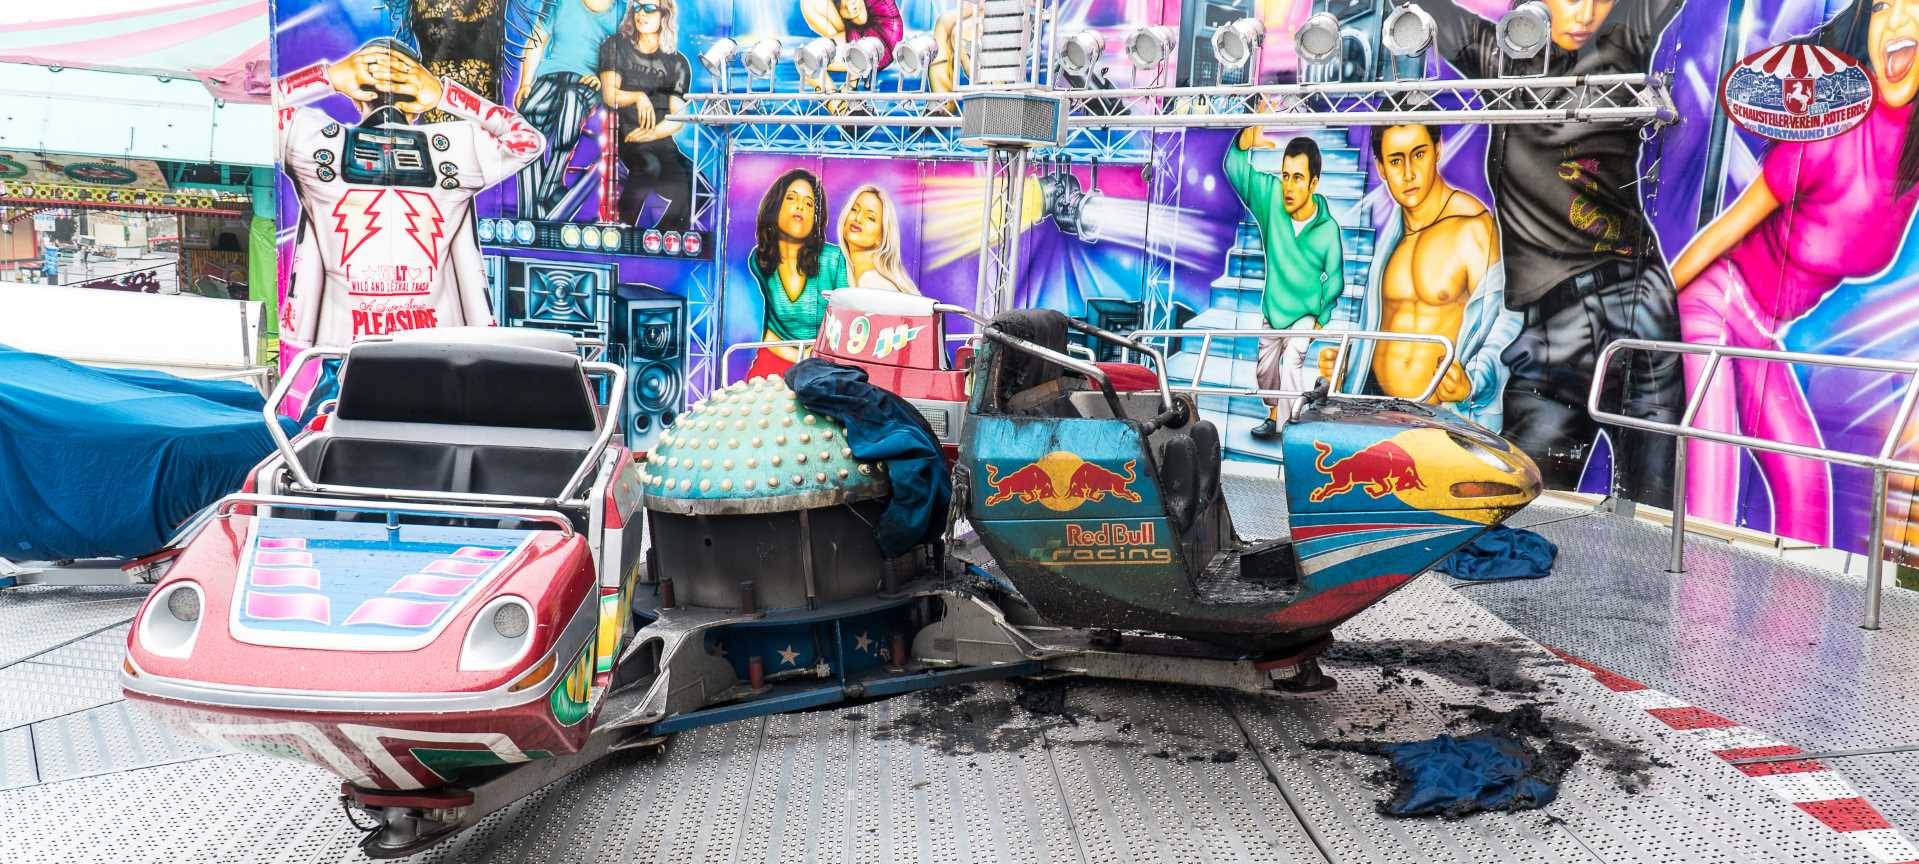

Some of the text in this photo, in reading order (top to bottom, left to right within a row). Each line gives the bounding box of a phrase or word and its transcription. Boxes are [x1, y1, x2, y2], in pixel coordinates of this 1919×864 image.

[1758, 124, 1825, 140] DORTMUND
[351, 281, 368, 292] WILD
[371, 281, 385, 292] AND
[387, 281, 409, 292] LETHAL
[352, 309, 438, 336] PLEASURE
[846, 316, 871, 354] 9
[1066, 521, 1155, 546] Red Bull
[1052, 547, 1172, 565] racing
